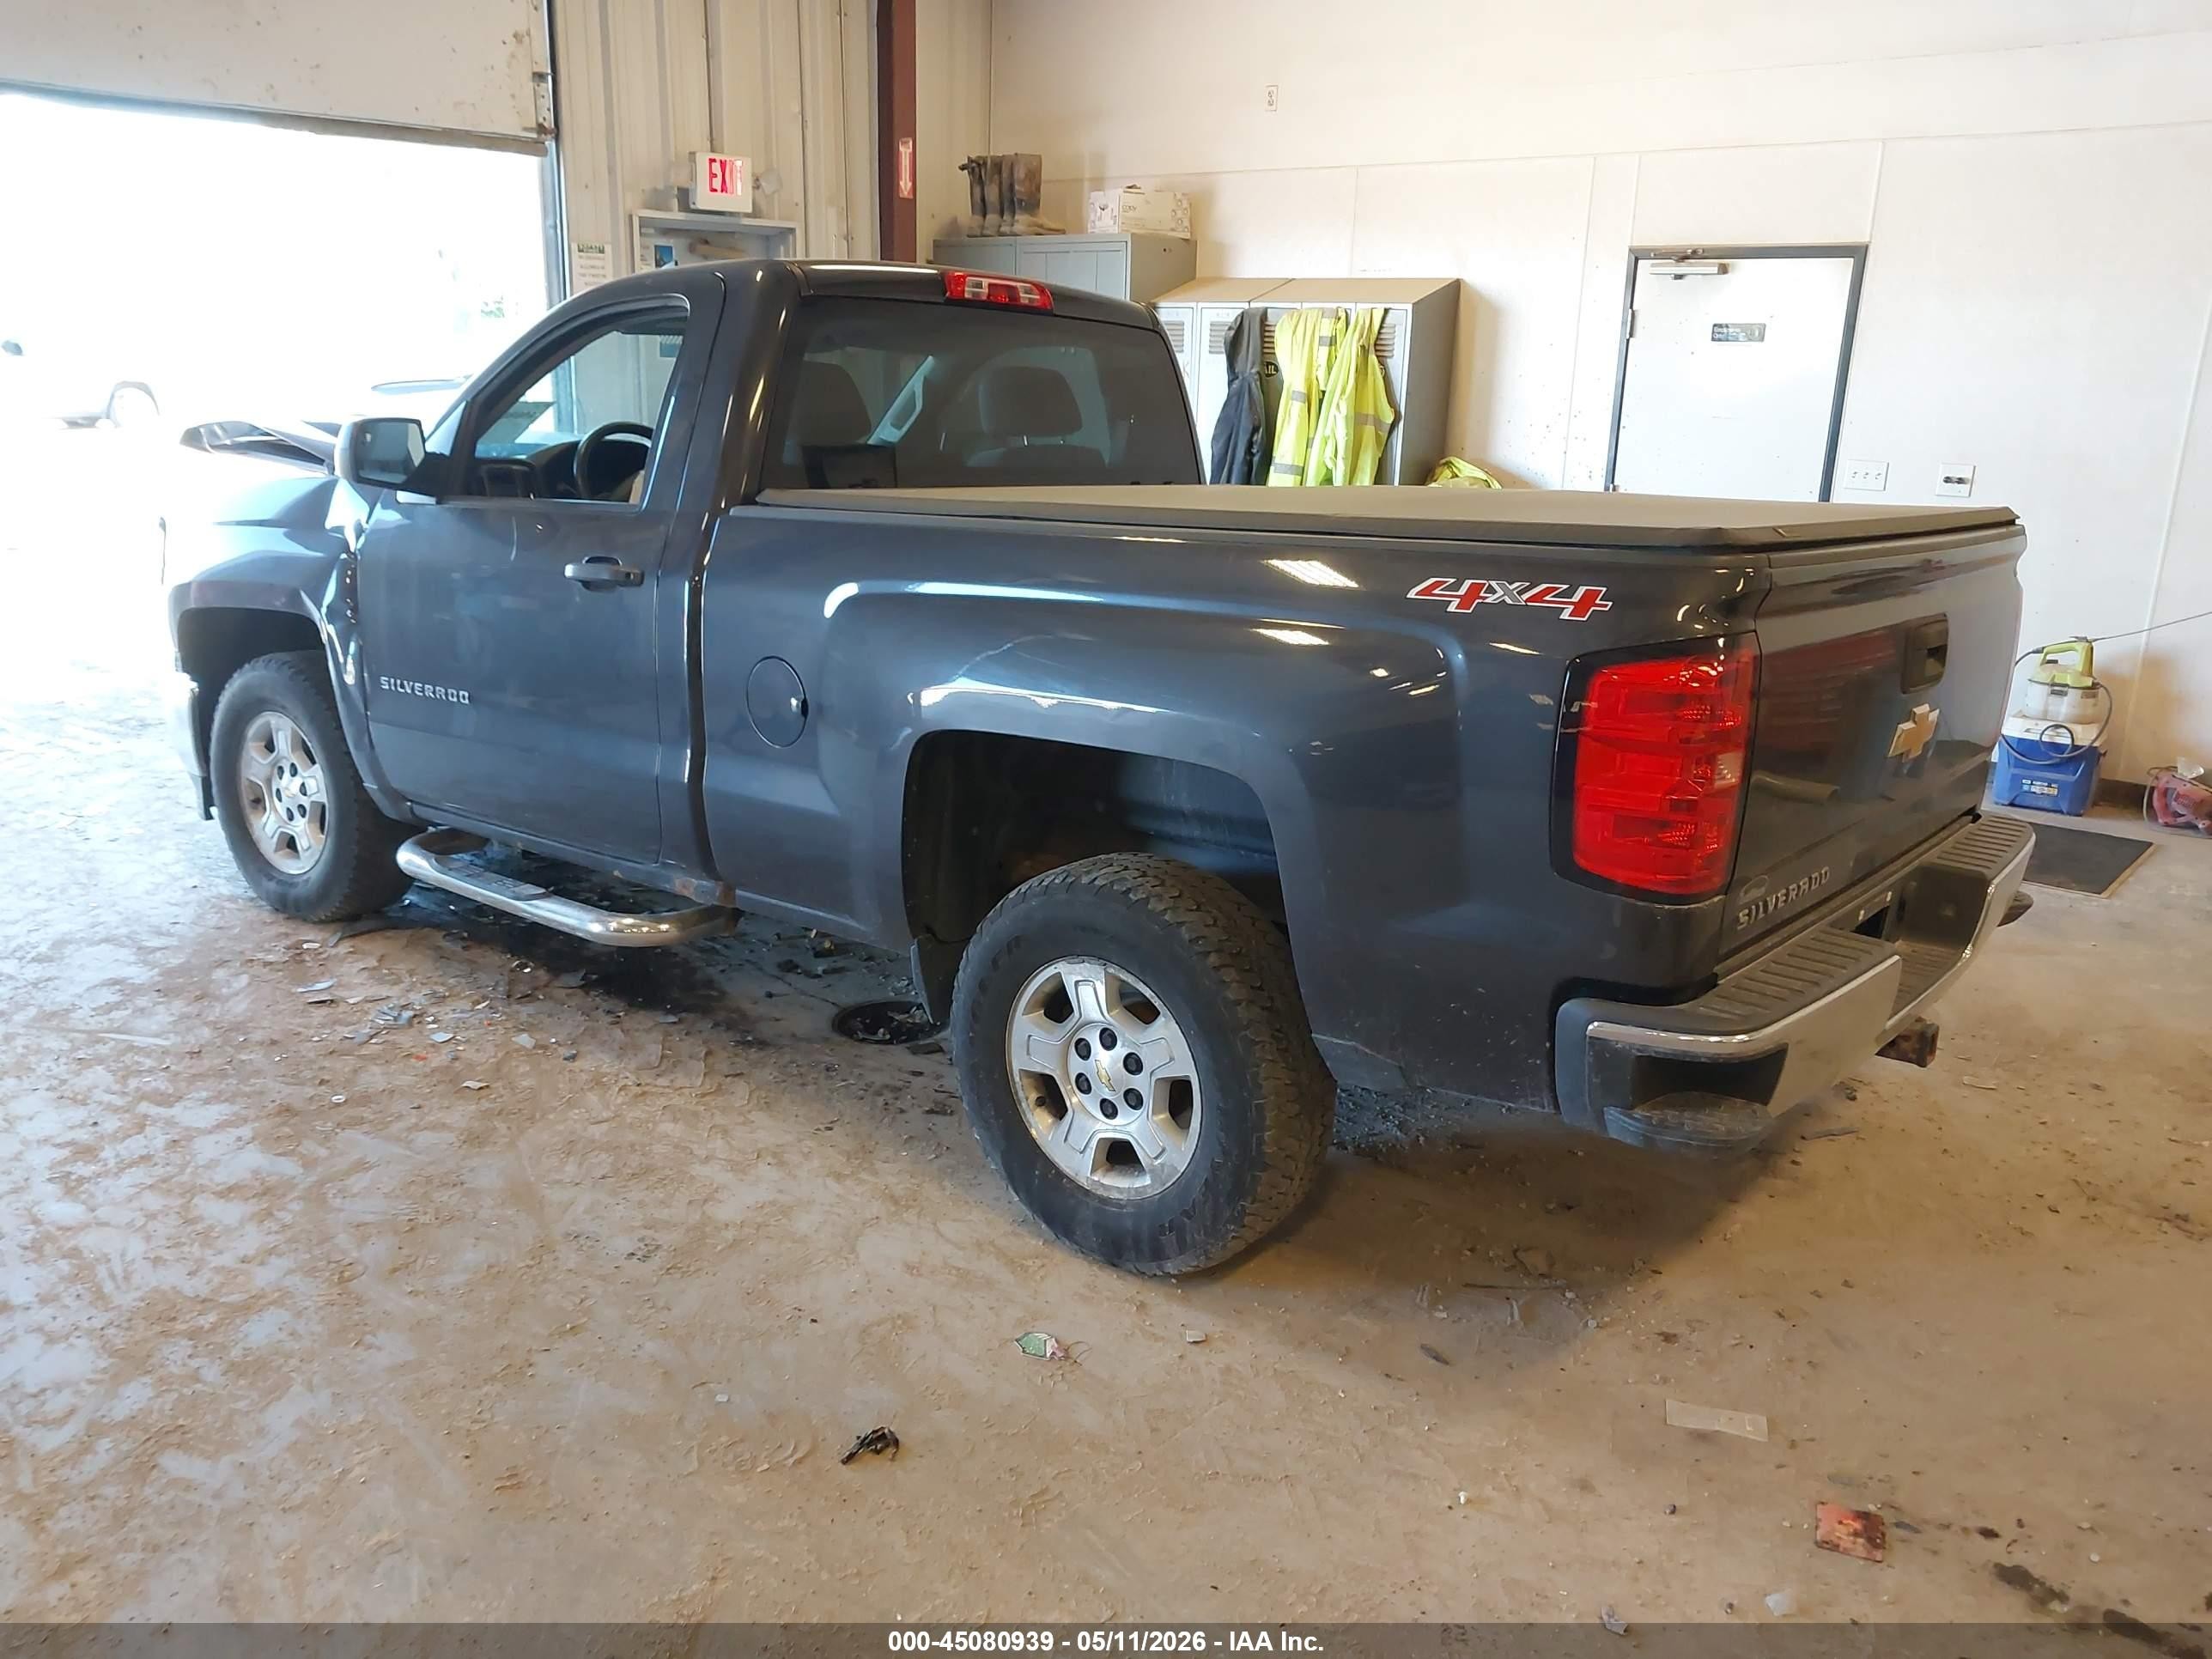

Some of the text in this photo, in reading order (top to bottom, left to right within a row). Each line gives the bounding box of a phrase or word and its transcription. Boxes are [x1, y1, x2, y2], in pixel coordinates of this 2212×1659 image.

[708, 157, 744, 196] EXIT
[380, 676, 470, 704] SILVERADO
[1736, 866, 1831, 930] SILVERADO
